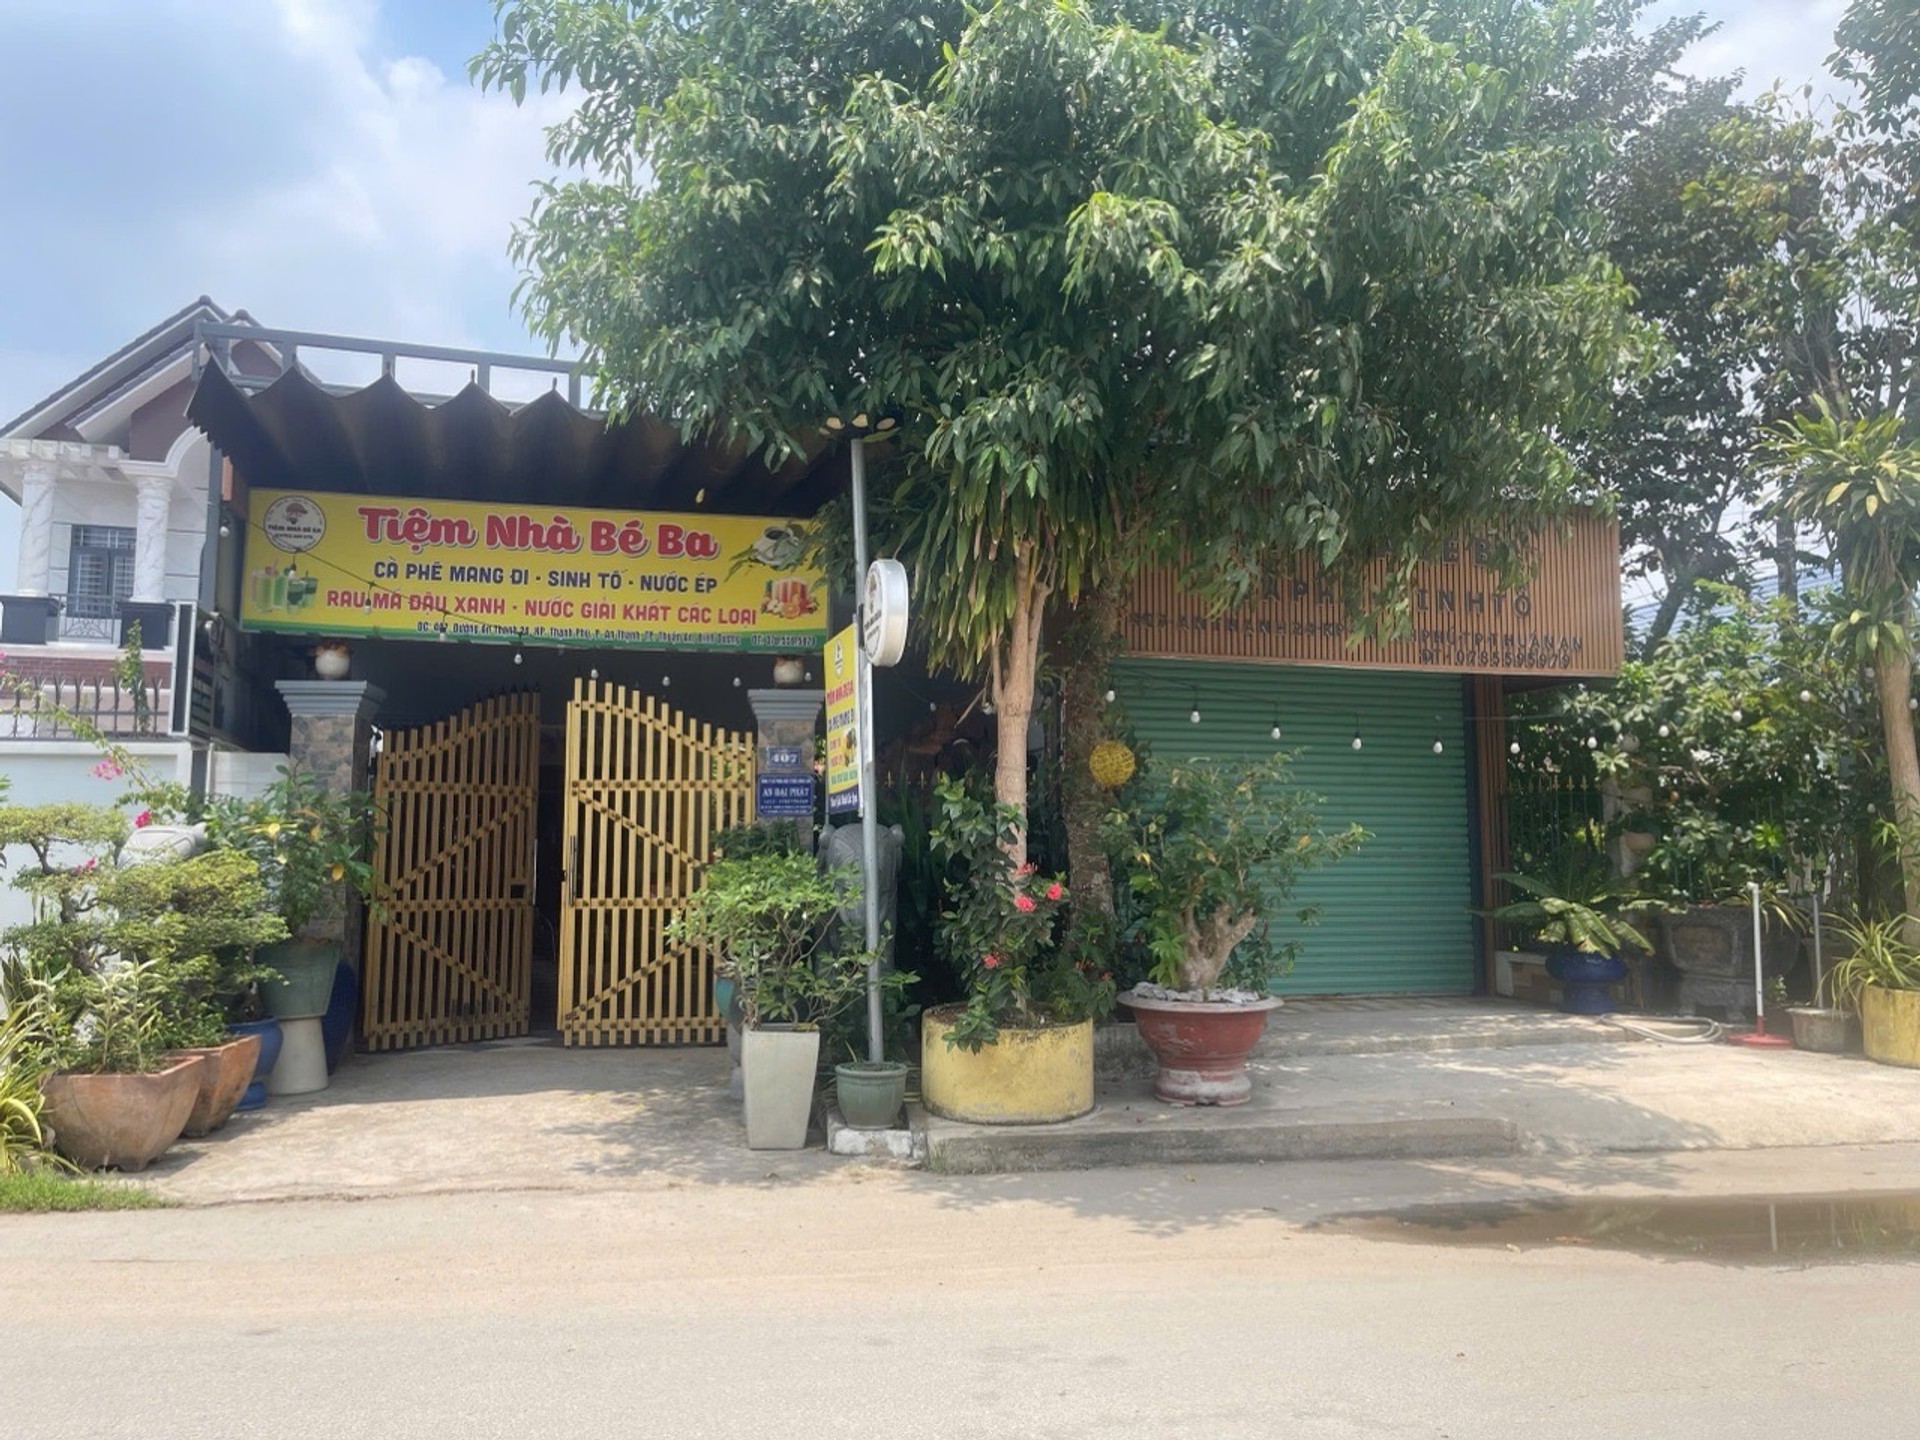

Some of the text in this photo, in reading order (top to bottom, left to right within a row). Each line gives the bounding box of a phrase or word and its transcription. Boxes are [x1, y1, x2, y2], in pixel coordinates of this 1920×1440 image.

[357, 506, 719, 558] Tiệm Nhà Bé Ba
[374, 556, 399, 579] CÀ
[405, 561, 443, 581] PHÊ
[449, 565, 504, 584] MANG
[510, 569, 529, 585] ĐI
[547, 570, 591, 588] SINH
[598, 569, 628, 589] TỐ
[640, 570, 689, 593] NƯỚC
[694, 571, 717, 593] ÉP
[327, 590, 366, 608] RAU
[372, 588, 402, 610] MÁ
[408, 591, 447, 615] ĐẬU
[453, 595, 506, 614] XANH
[524, 596, 575, 618] NƯỚC
[622, 599, 672, 622] KHÁT
[677, 602, 712, 623] CÁC
[717, 607, 756, 628] LOẠI
